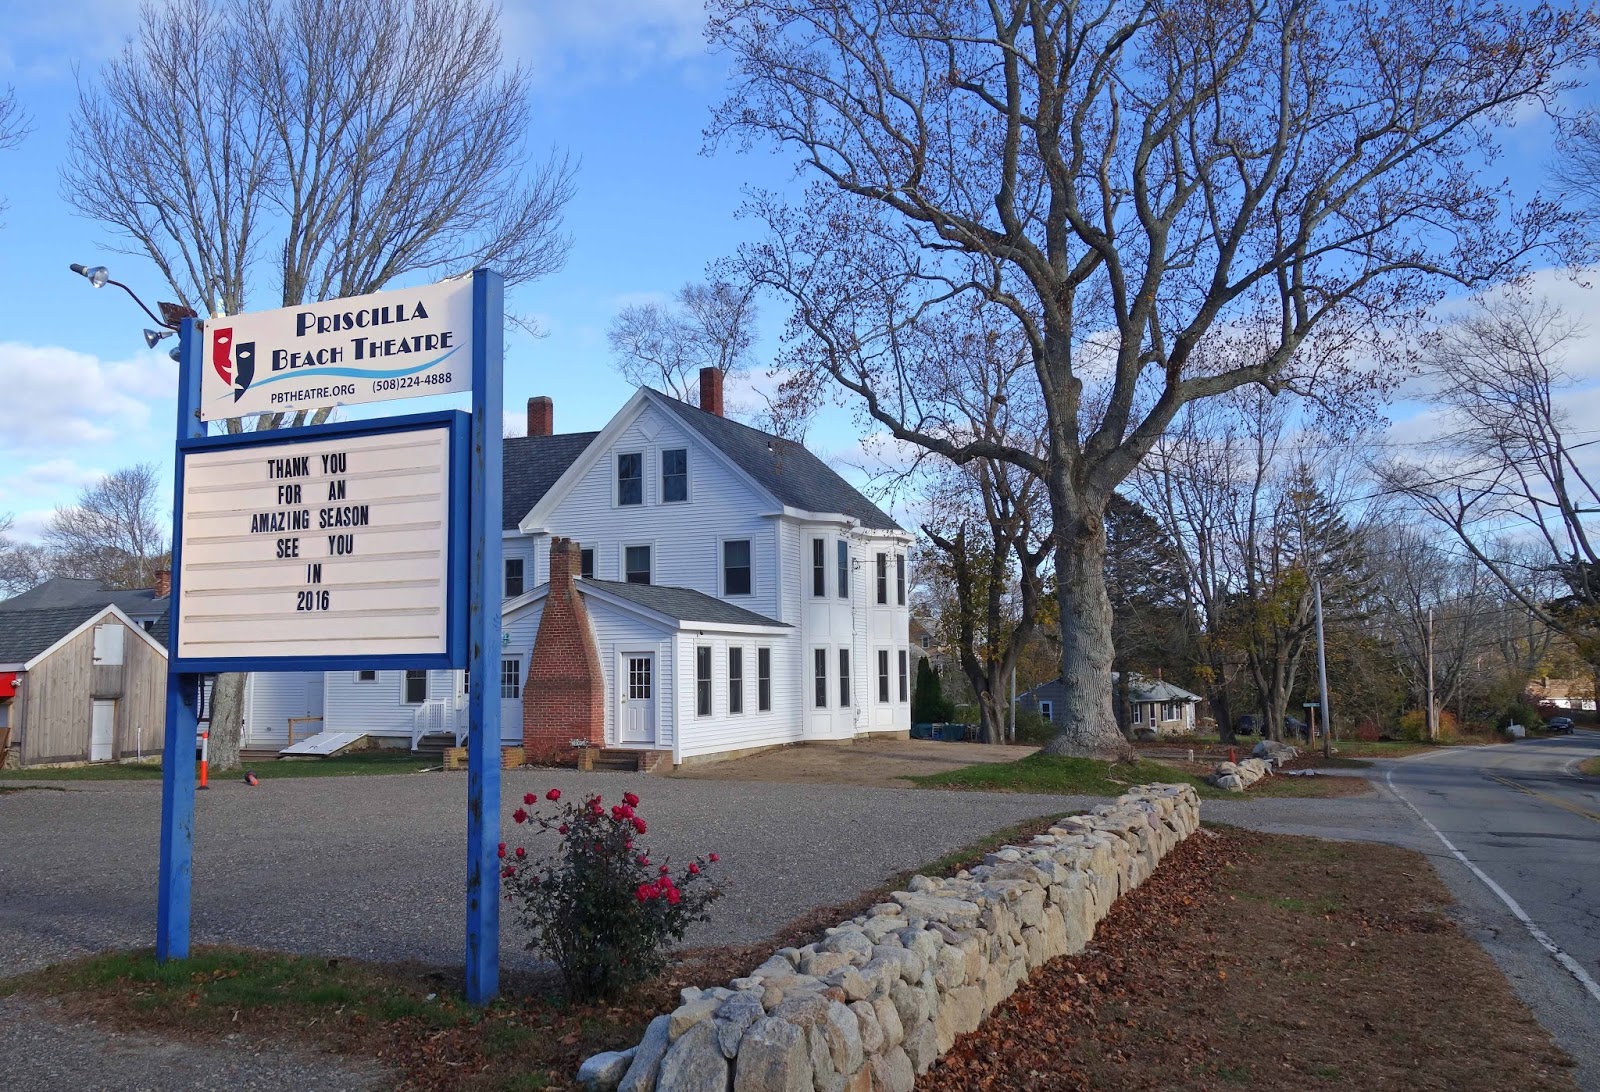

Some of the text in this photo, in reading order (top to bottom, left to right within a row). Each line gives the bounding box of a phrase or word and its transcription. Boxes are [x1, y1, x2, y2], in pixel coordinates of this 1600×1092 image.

[270, 372, 453, 404] PBTHEATRE.ORG (508)224-4888
[267, 453, 347, 479] THANK YOU
[278, 480, 346, 505] FOR AN
[250, 505, 369, 533] AMAZING SEASON
[276, 534, 353, 558] SEE YOU
[307, 563, 322, 584] IN
[296, 590, 330, 611] 2016
